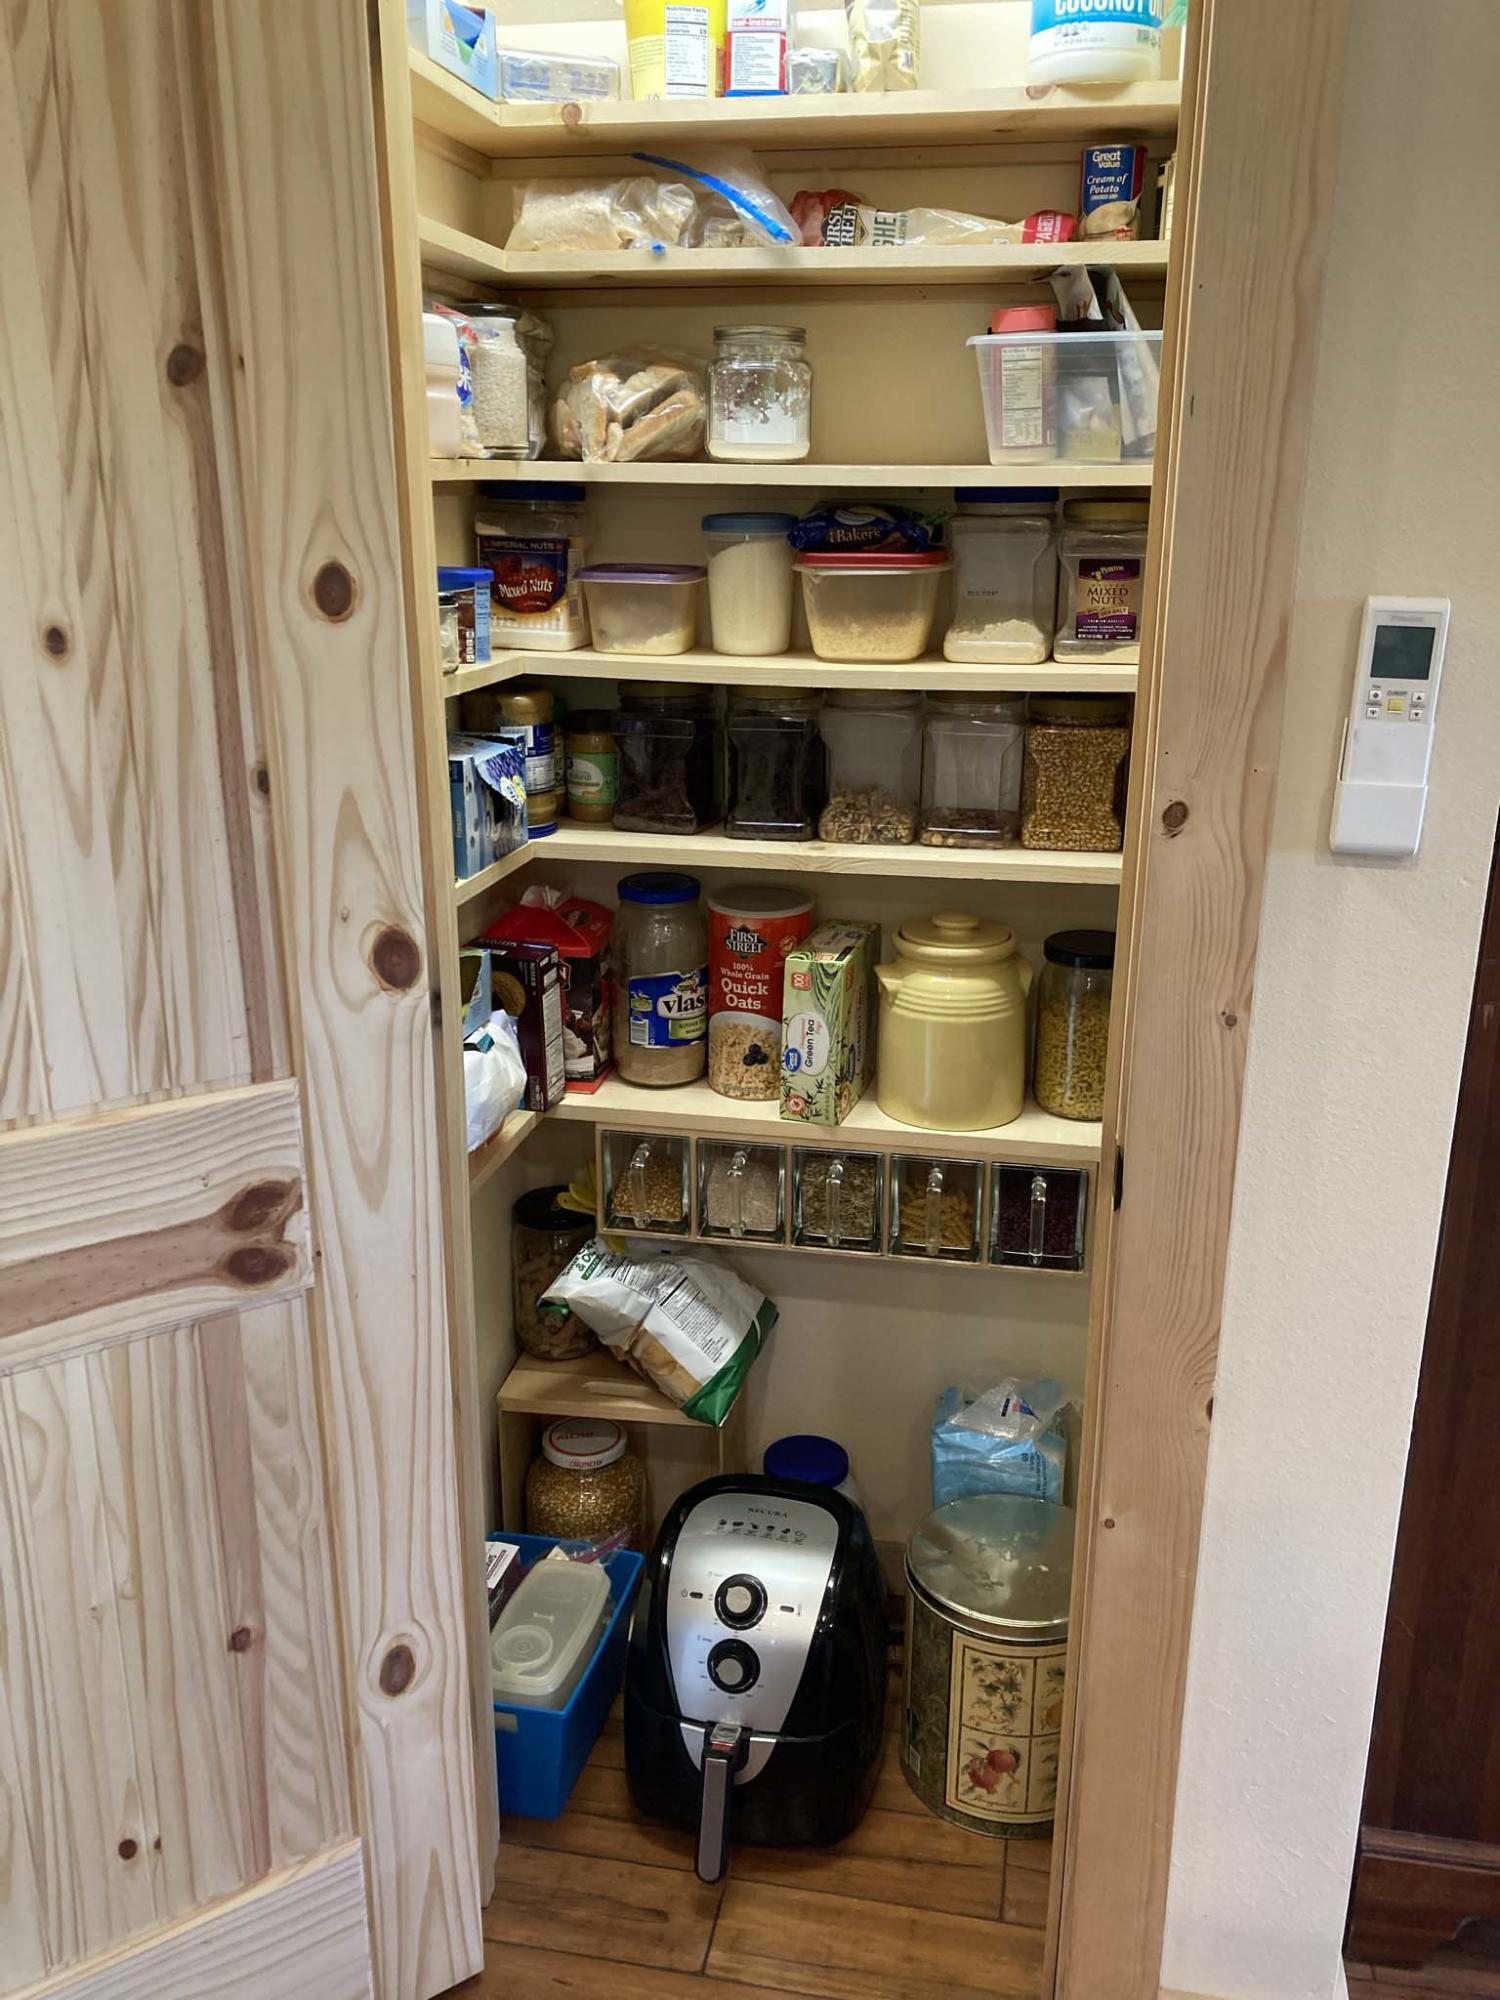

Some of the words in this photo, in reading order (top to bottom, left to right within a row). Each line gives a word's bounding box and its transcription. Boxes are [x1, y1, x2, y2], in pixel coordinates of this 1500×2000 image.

[1092, 150, 1121, 162] Great
[1098, 161, 1121, 169] Value
[1086, 175, 1115, 185] Cream
[1116, 173, 1129, 185] of
[1089, 185, 1120, 195] Potato
[498, 580, 528, 598] Mixed
[529, 578, 554, 593] Nuts
[1087, 587, 1129, 596] MIXED
[1091, 596, 1125, 605] NUTS
[730, 928, 760, 943] FIRST
[726, 940, 764, 953] STREET
[720, 967, 743, 978] Whole
[744, 972, 770, 980] Grain
[733, 962, 754, 972] 100%
[721, 977, 769, 995] Quick
[793, 973, 806, 988] 100
[725, 994, 762, 1009] Oats
[806, 1019, 815, 1036] Tea
[805, 1038, 814, 1068] Green
[748, 1507, 788, 1519] SECURA
